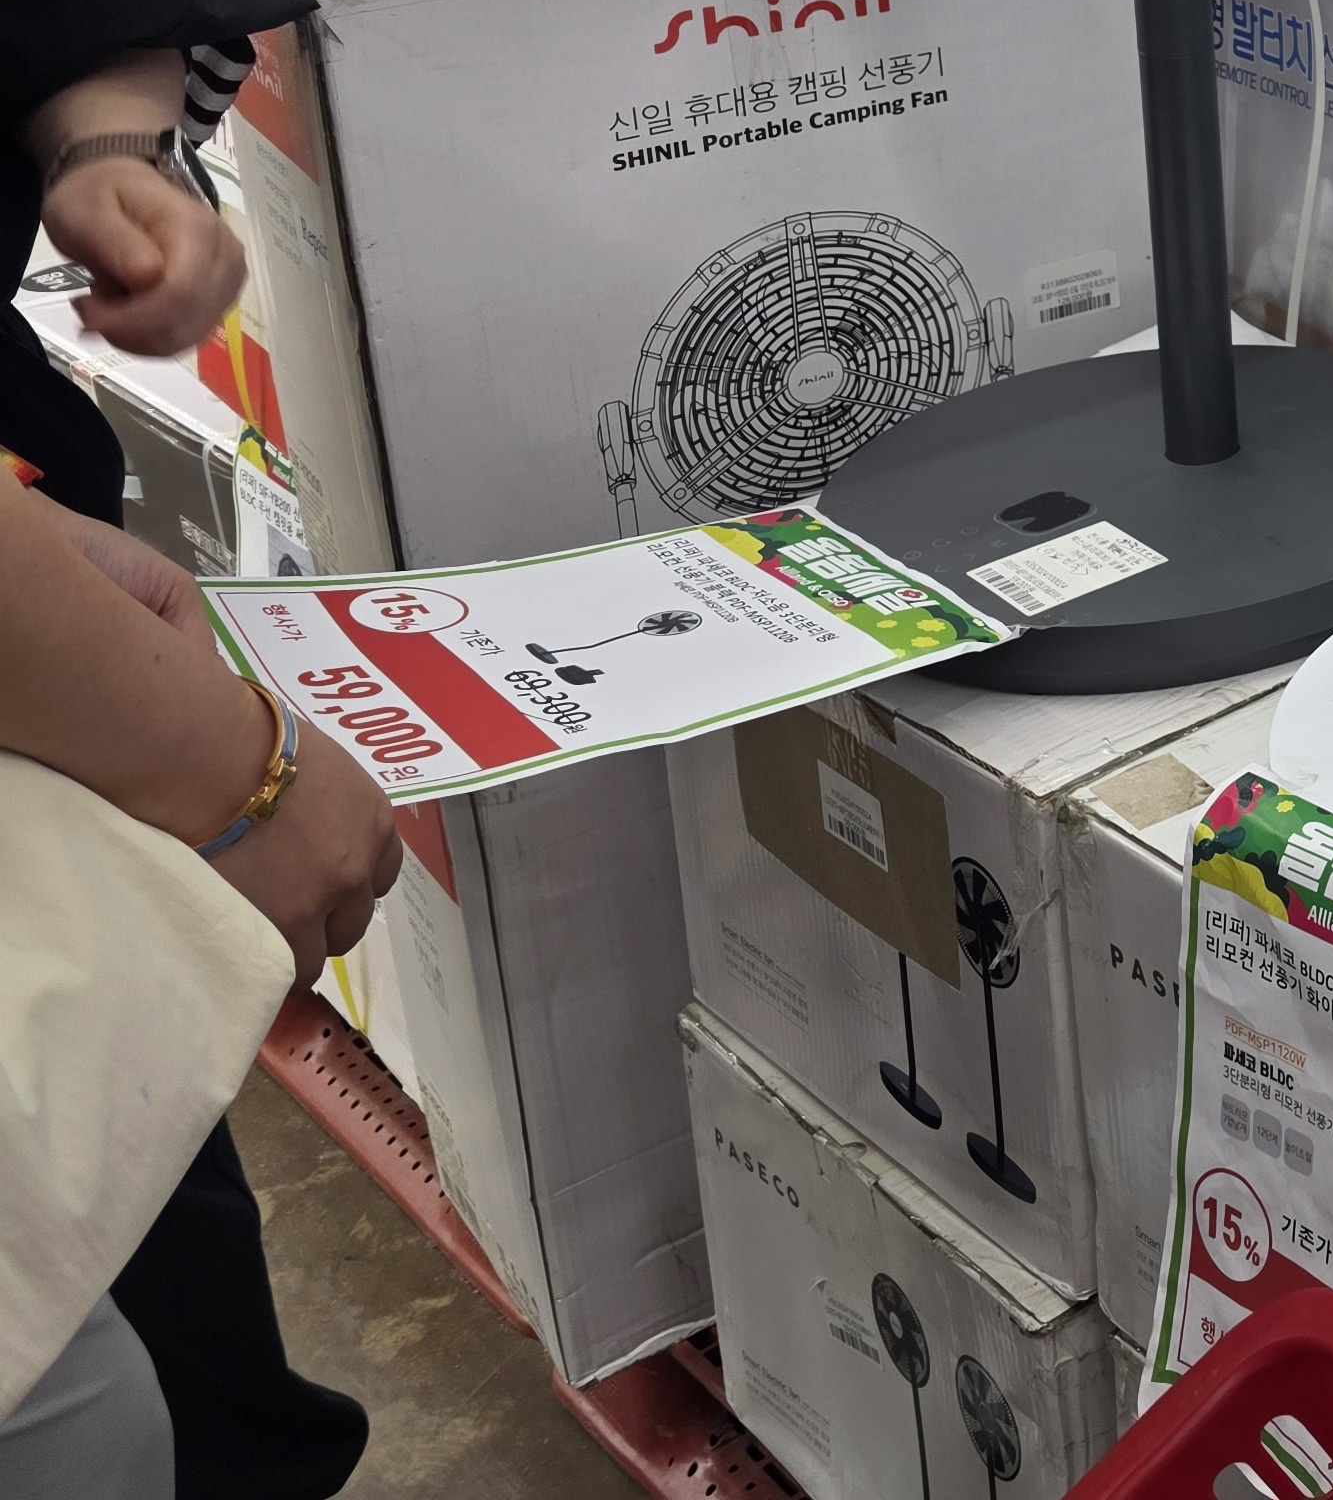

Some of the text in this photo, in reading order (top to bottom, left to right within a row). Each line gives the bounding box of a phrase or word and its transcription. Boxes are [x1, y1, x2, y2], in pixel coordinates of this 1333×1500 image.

[607, 45, 946, 144] 신일 휴대용 캠핑 선풍기
[1214, 58, 1258, 90] REMOTE
[1260, 76, 1312, 110] CONTROL
[611, 88, 949, 173] SHINIL Portable Camping Fan
[646, 544, 687, 567] 리모컨
[673, 564, 716, 587] 선풍기
[703, 582, 739, 600] 블랙
[664, 537, 841, 644] [리퍼] 파세코 BLDC 저소음 3단분리형
[777, 535, 943, 616] 올봄세일
[261, 603, 308, 642] 행사가
[370, 590, 431, 632] 15%
[458, 628, 507, 658] 기존가
[297, 665, 444, 784] 59,000원
[1204, 908, 1253, 947] [리퍼]
[1254, 927, 1297, 971] 파세코
[1205, 935, 1256, 974] 리모컨
[1258, 957, 1303, 1001] 선풍기
[1223, 1017, 1307, 1070] PDF-MSP1120W
[1223, 1040, 1295, 1092] 파세코 BLDC
[1222, 1063, 1272, 1101] 3단분리형
[1272, 1084, 1304, 1121] 리모컨
[713, 1126, 801, 1209] PASECO
[1134, 1224, 1162, 1252] Smart
[1202, 1195, 1262, 1270] 15%
[1280, 1212, 1333, 1266] 기존가
